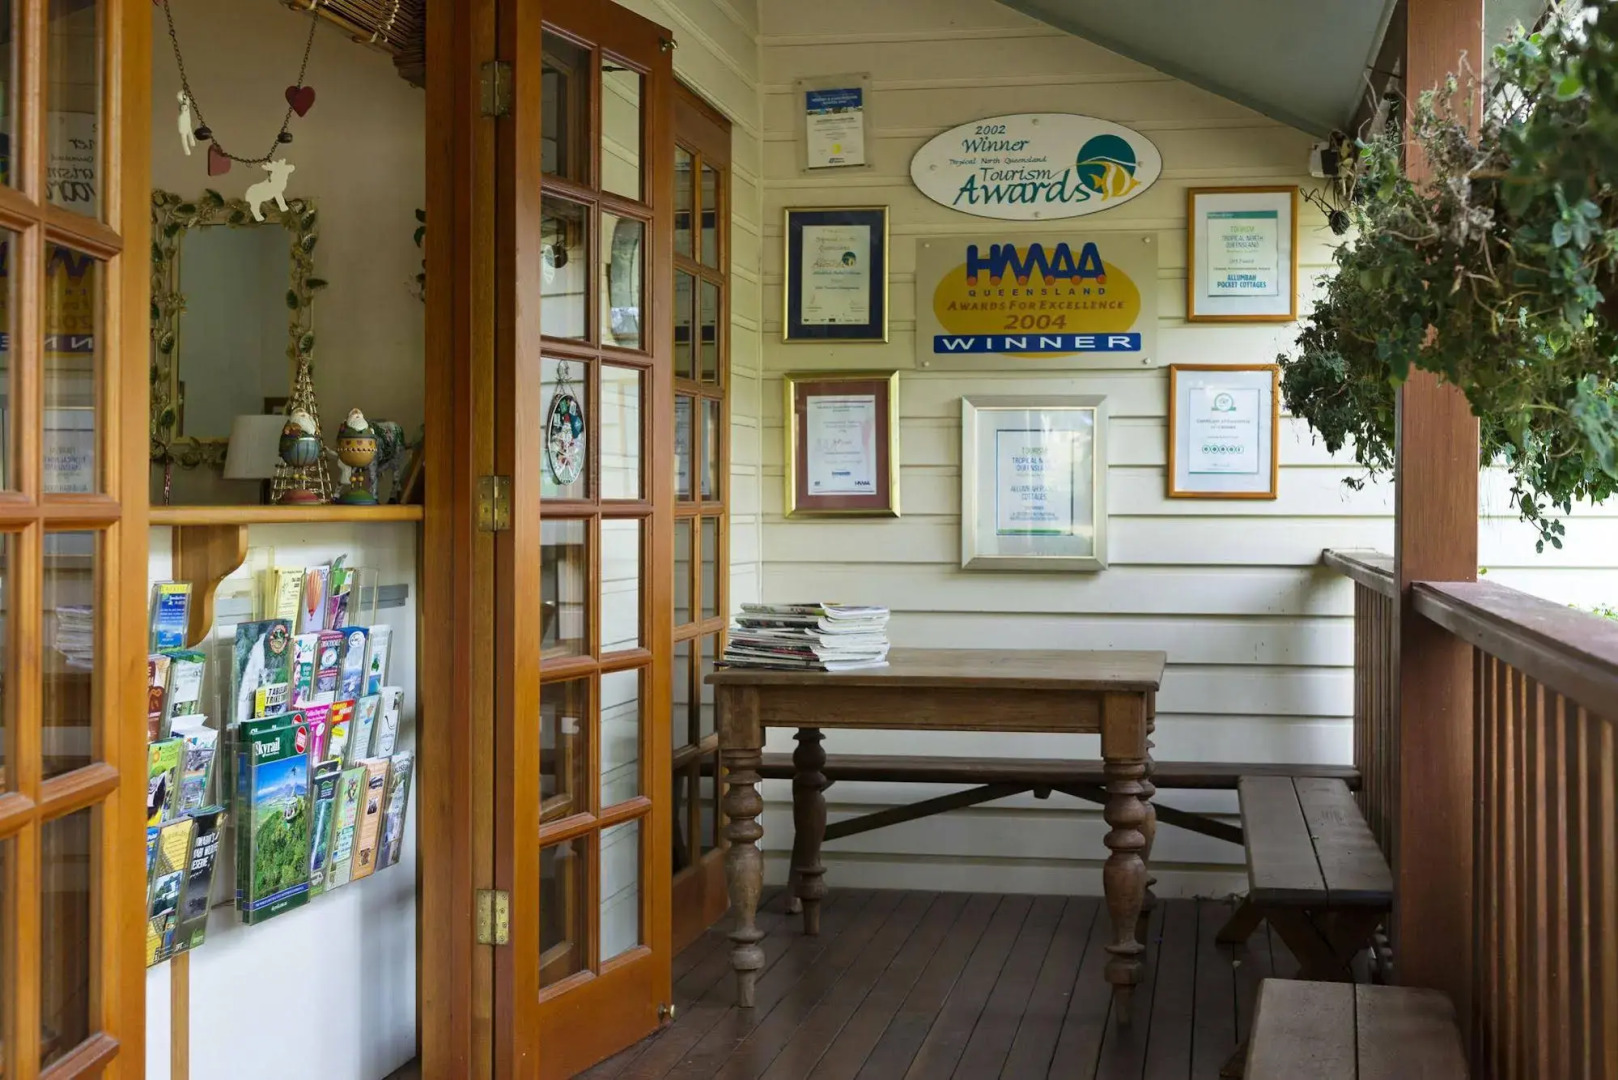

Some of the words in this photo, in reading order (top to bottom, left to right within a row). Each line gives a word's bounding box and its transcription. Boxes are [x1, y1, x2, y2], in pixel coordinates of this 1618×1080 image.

[975, 125, 1006, 135] 2002
[962, 138, 1030, 153] Winner
[1004, 156, 1047, 164] Queensland
[980, 167, 1051, 181] Tourism
[952, 169, 1091, 205] Awards
[966, 242, 1106, 286] HMAA
[968, 287, 1106, 297] QUEENSLAND
[947, 300, 1006, 311] AWARDS
[1009, 300, 1036, 310] FOR
[1039, 300, 1125, 310] EXCELLENCE
[1004, 314, 1068, 330] 2004
[942, 336, 1133, 350] WINNER
[254, 737, 280, 757] Skyrail
